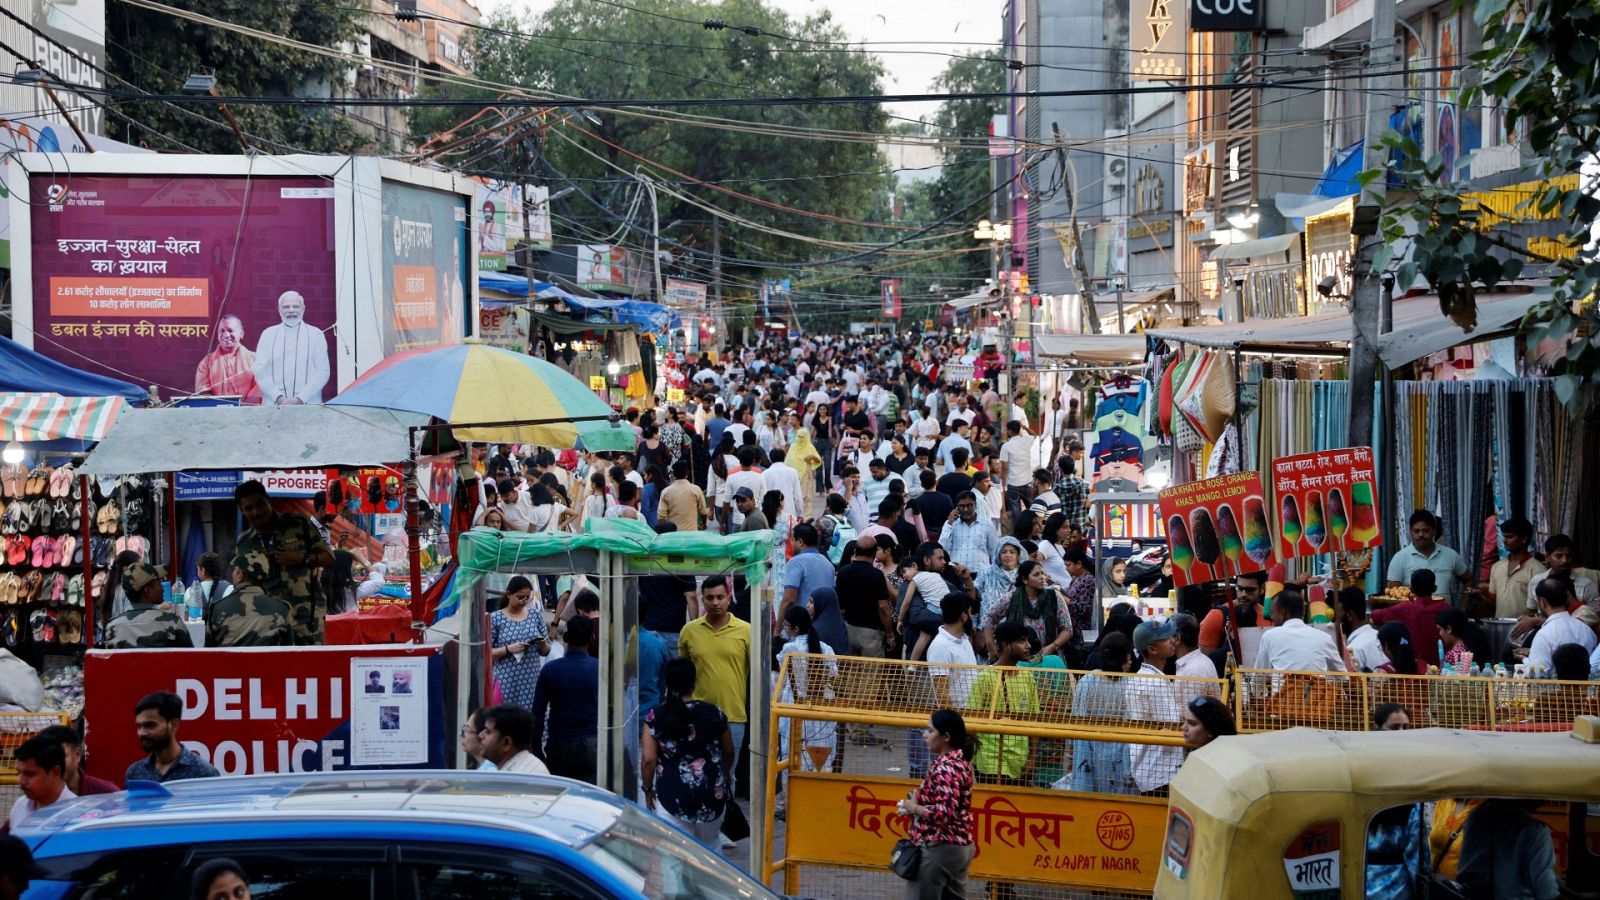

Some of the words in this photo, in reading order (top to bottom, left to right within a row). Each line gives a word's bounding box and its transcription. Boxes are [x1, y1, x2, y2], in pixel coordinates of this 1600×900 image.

[35, 36, 101, 89] BRIDAL
[91, 260, 113, 273] का
[58, 287, 73, 296] 2.61
[74, 285, 93, 297] करोड़
[166, 288, 176, 297] का
[177, 286, 202, 297] निर्माण
[89, 300, 98, 309] 10
[99, 299, 118, 311] करोड़
[120, 299, 135, 309] लोग
[51, 323, 88, 337] डबल
[92, 320, 131, 338] इंजन
[134, 319, 155, 337] की
[158, 324, 209, 338] सरकार
[1276, 461, 1294, 473] काला
[1160, 488, 1179, 499] KALA
[1205, 475, 1227, 489] ROSE,
[1226, 471, 1258, 485] ORANGE,
[1174, 495, 1196, 508] KHAS,
[1196, 490, 1222, 503] MANGO,
[1223, 484, 1247, 498] LEMON
[176, 678, 342, 720] DELHI
[1055, 854, 1097, 870] LAJPAT
[1102, 858, 1142, 874] NAGAR
[1294, 858, 1335, 886] भारत
